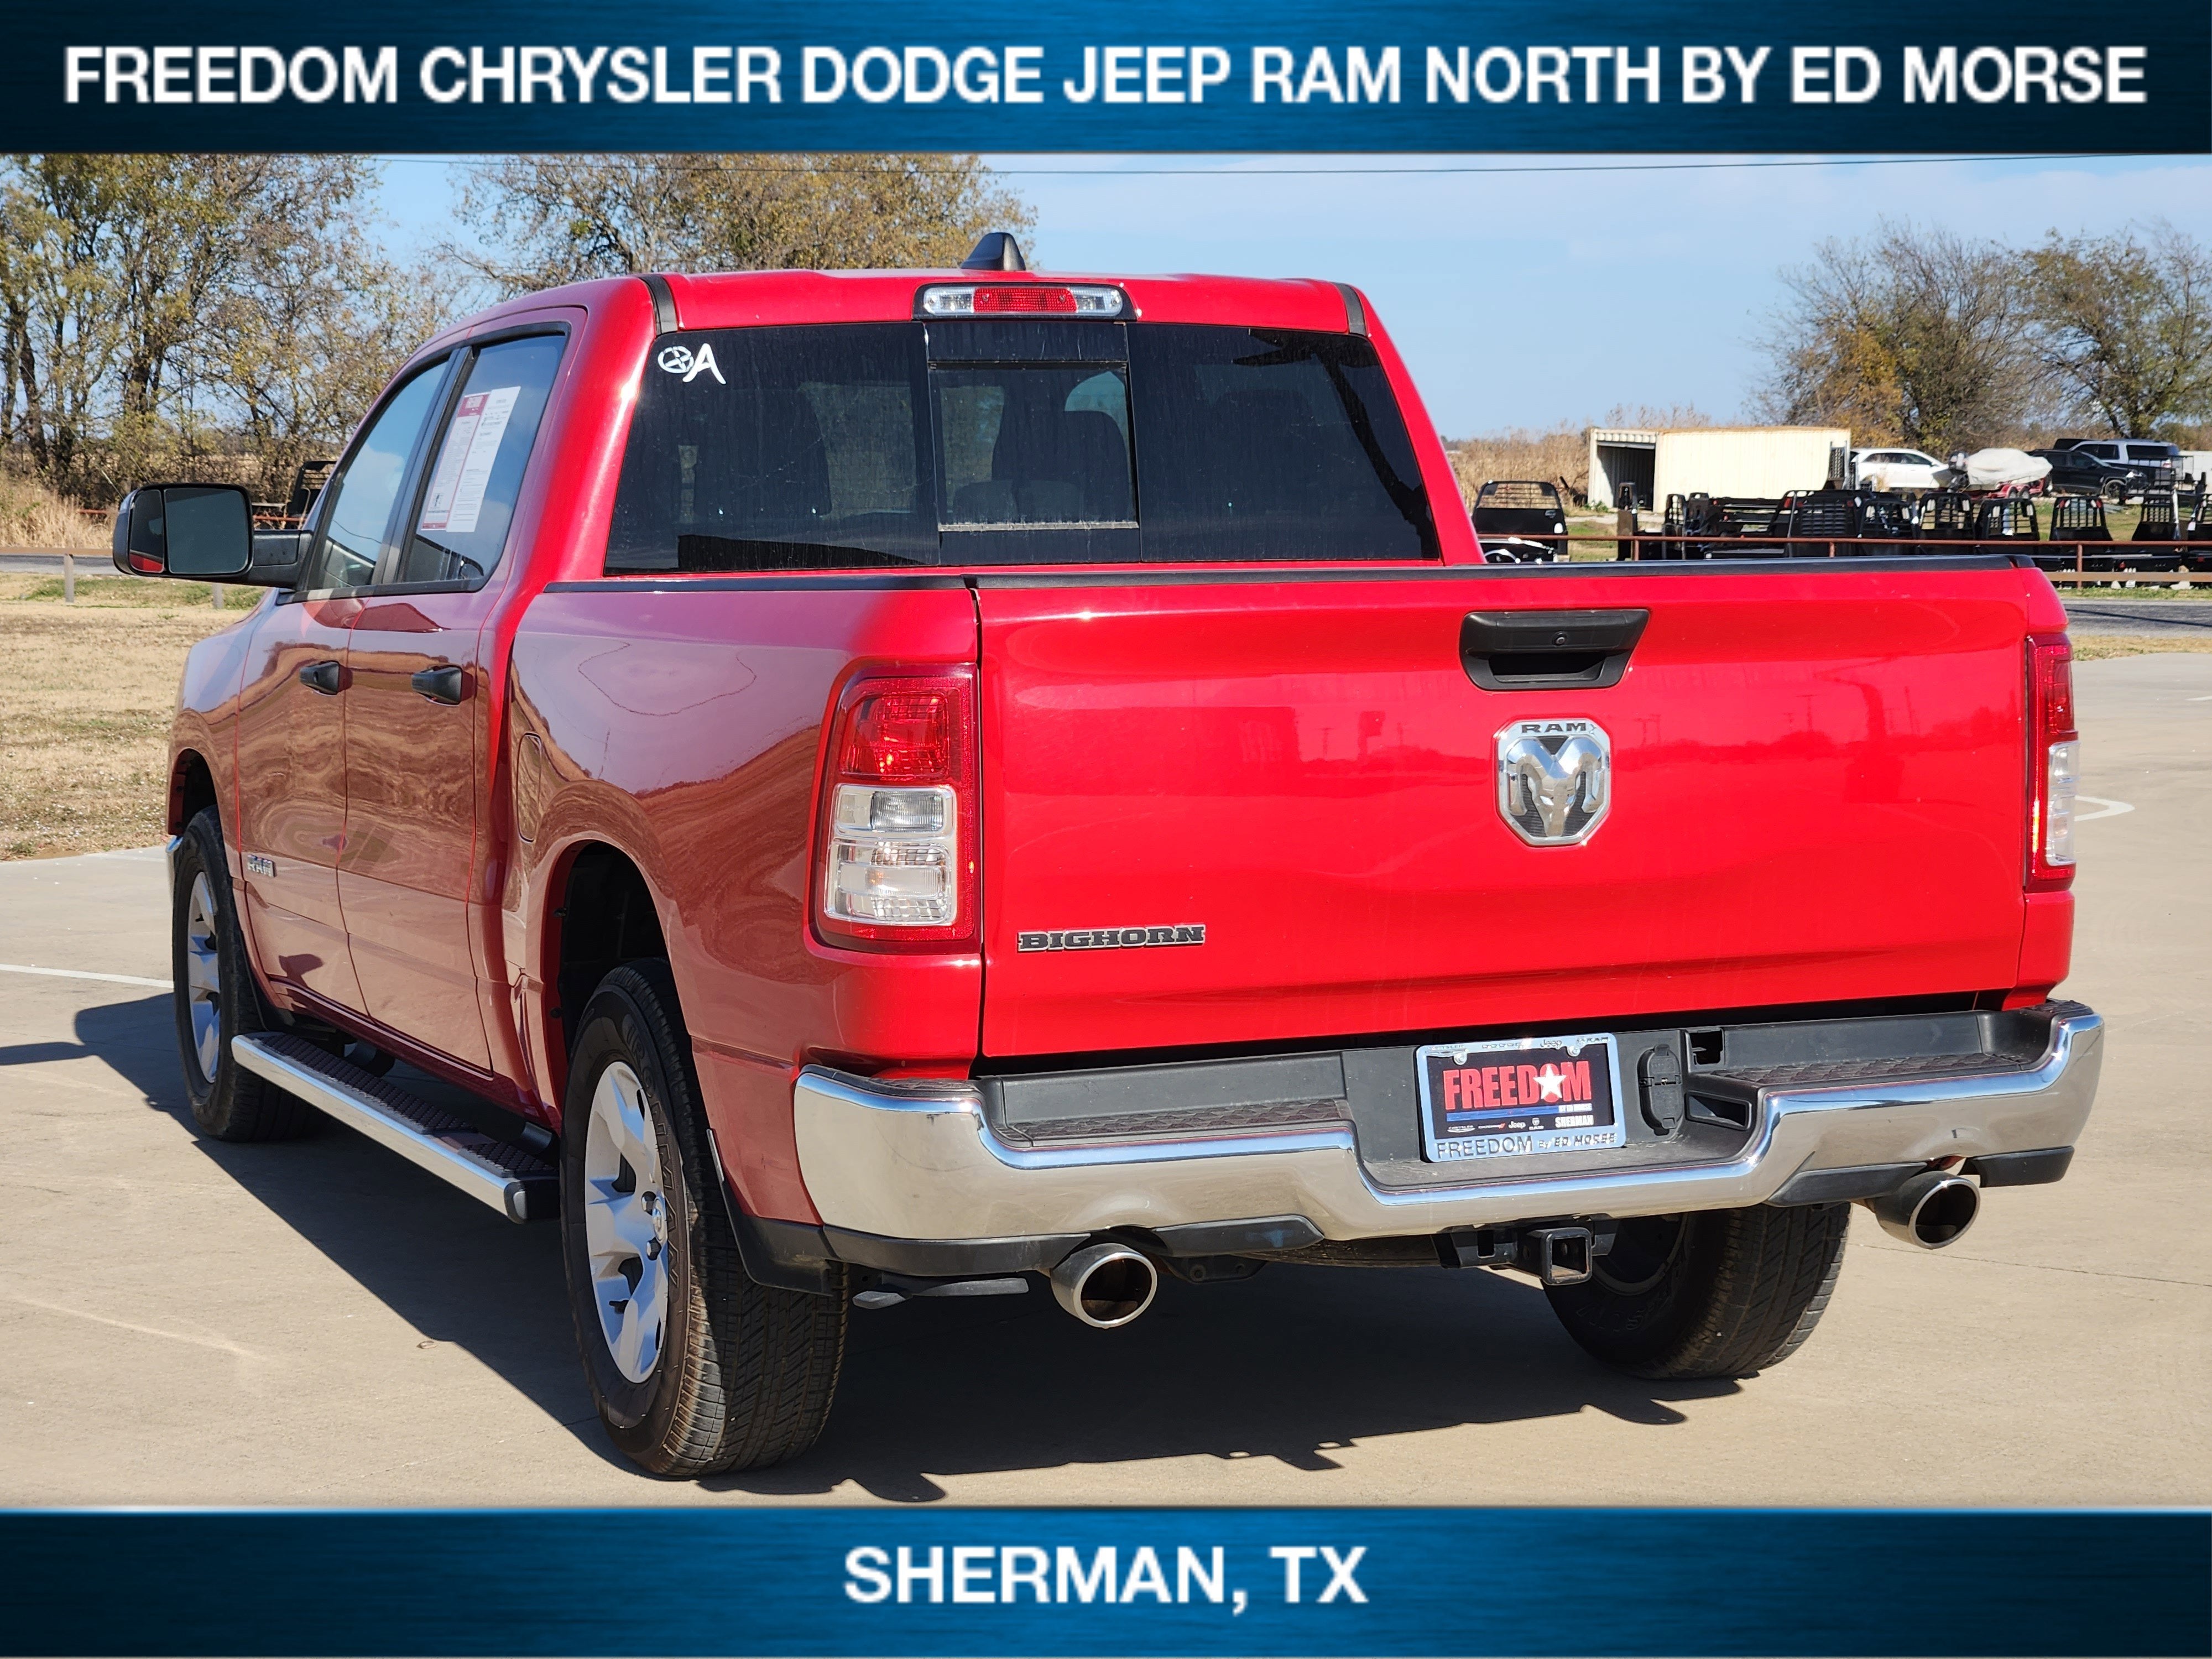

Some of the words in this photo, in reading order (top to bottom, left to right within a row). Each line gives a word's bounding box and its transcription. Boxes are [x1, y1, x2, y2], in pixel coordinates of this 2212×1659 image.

[1521, 723, 1587, 733] RAM
[1018, 924, 1206, 952] BIGHORN
[1508, 1120, 1526, 1129] Jeep
[1555, 1115, 1594, 1128] SHERMAN
[1437, 1135, 1533, 1159] FREEDOM
[1554, 1136, 1569, 1146] ED
